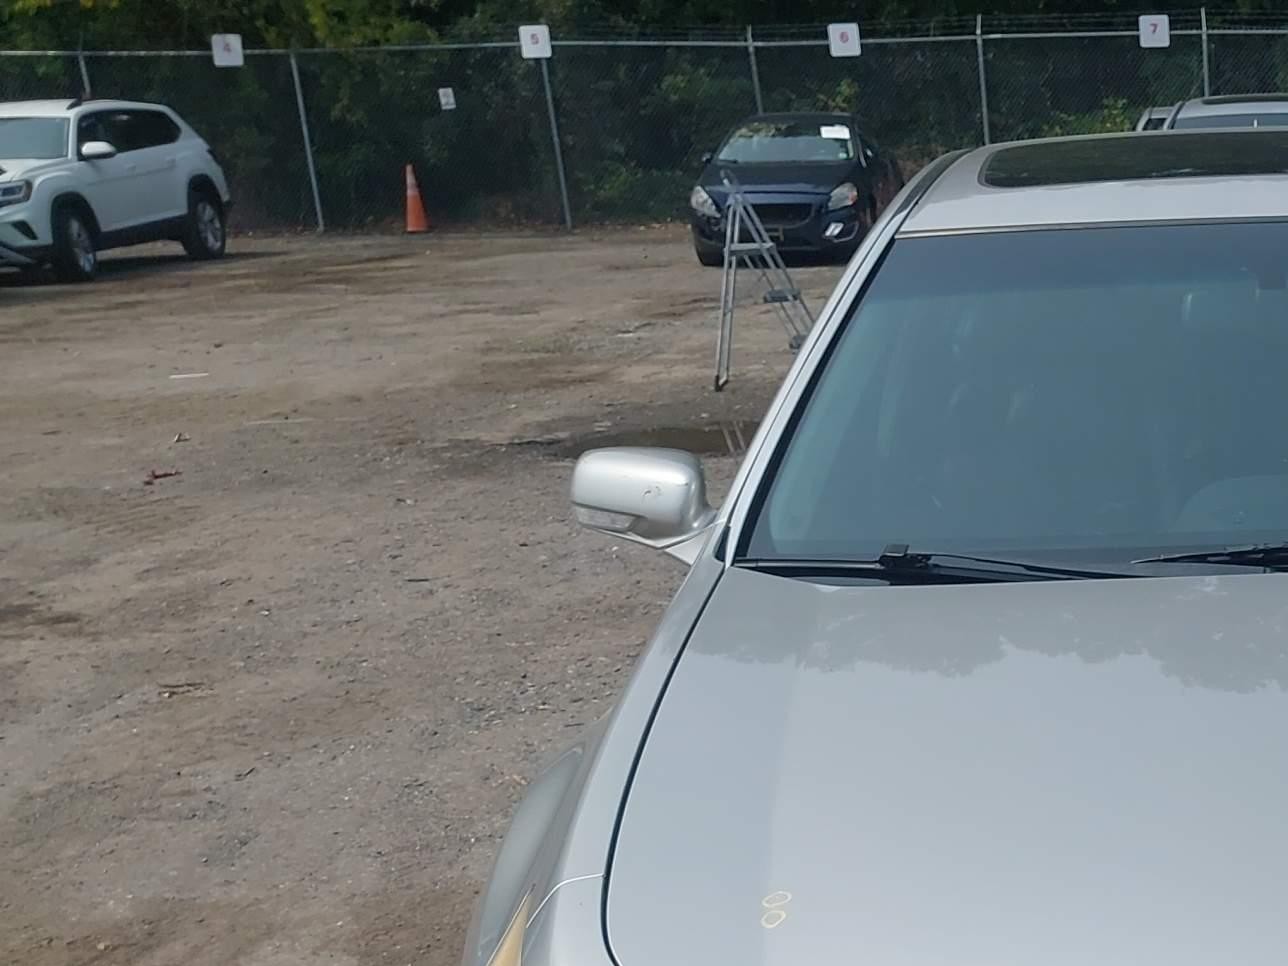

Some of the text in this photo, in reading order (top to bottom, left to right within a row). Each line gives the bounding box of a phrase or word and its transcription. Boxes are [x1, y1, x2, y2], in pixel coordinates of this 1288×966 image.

[1149, 23, 1159, 34] 7
[530, 33, 540, 45] 5
[839, 31, 849, 43] 6
